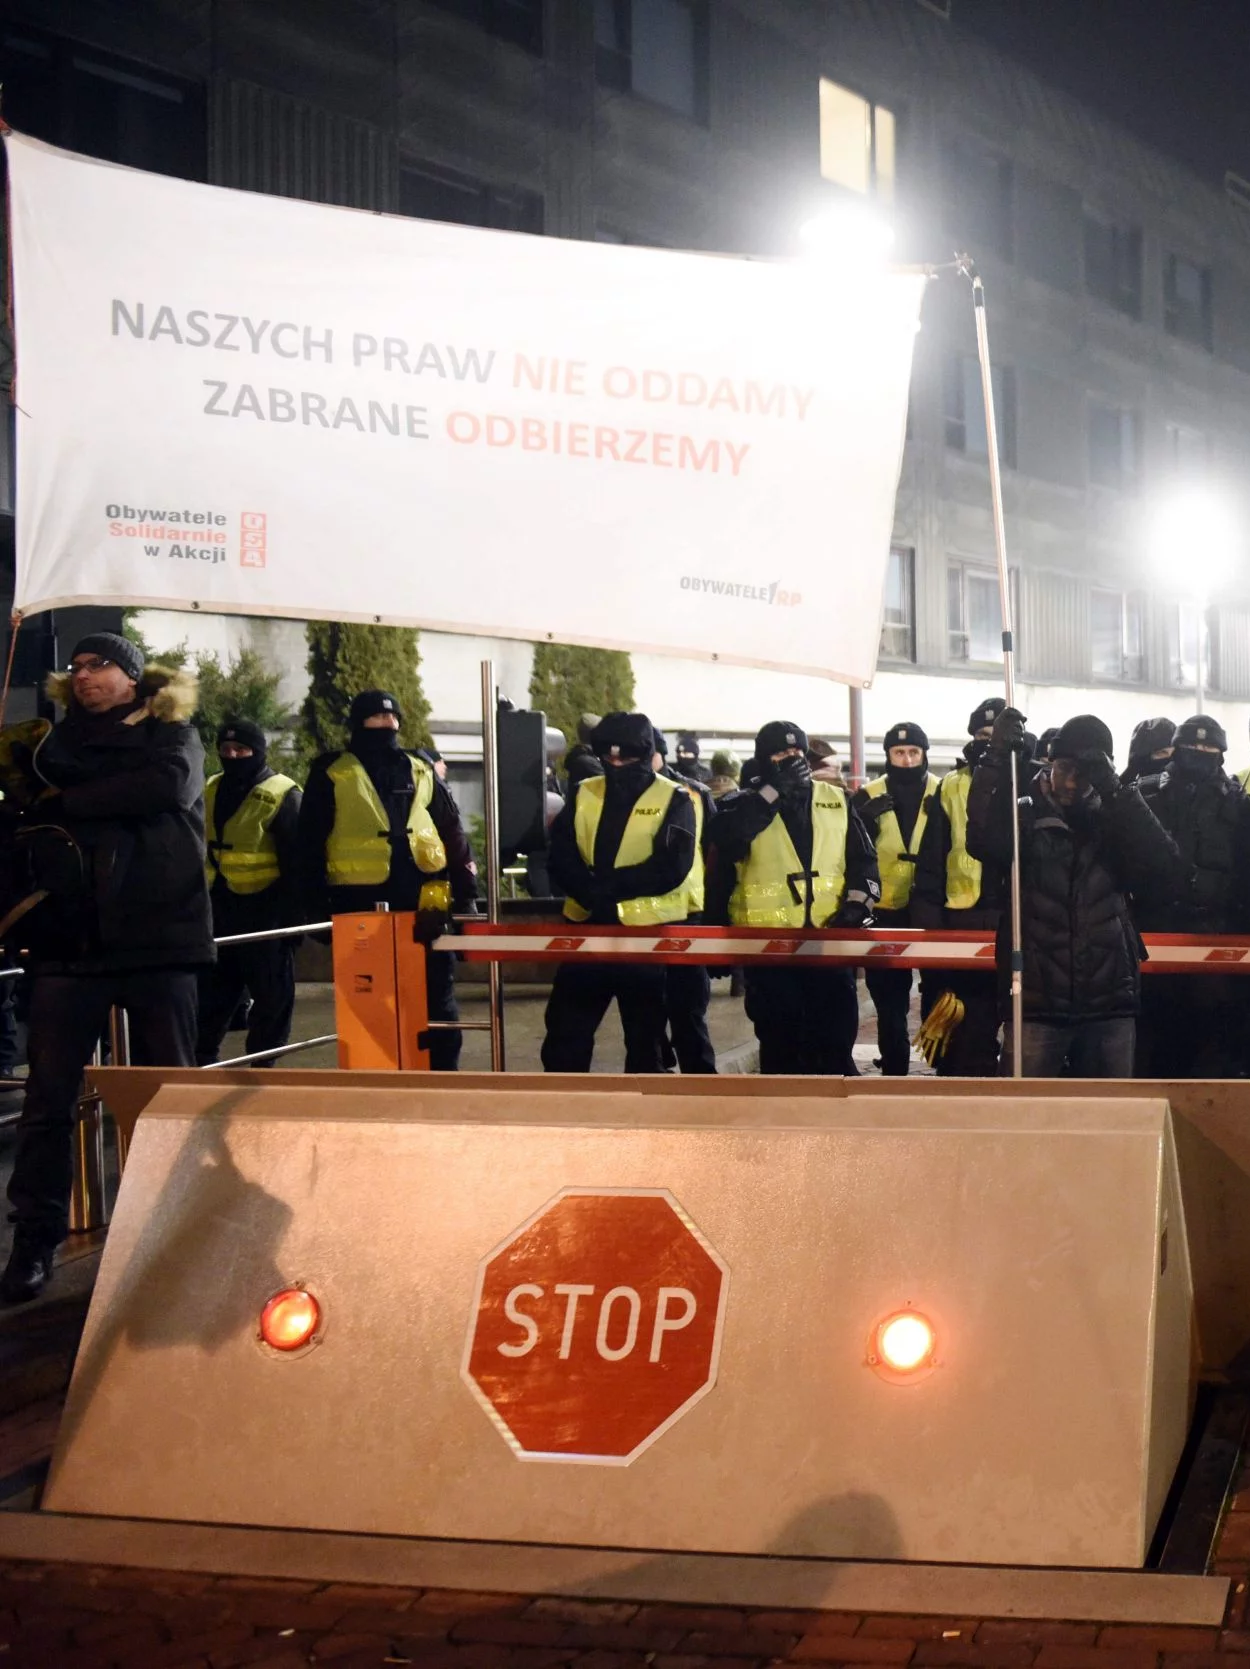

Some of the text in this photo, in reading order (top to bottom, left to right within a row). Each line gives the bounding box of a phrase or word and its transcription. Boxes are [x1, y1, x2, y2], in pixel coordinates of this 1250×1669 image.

[110, 297, 817, 422] NASZYCH PRAW NIE ODDAMY
[202, 378, 752, 478] ZABRANE ODBIERZEMY
[105, 503, 227, 526] Obywatele
[109, 521, 227, 545] Solidarnie
[144, 543, 227, 564] w Akcji
[498, 1283, 697, 1362] STOP
